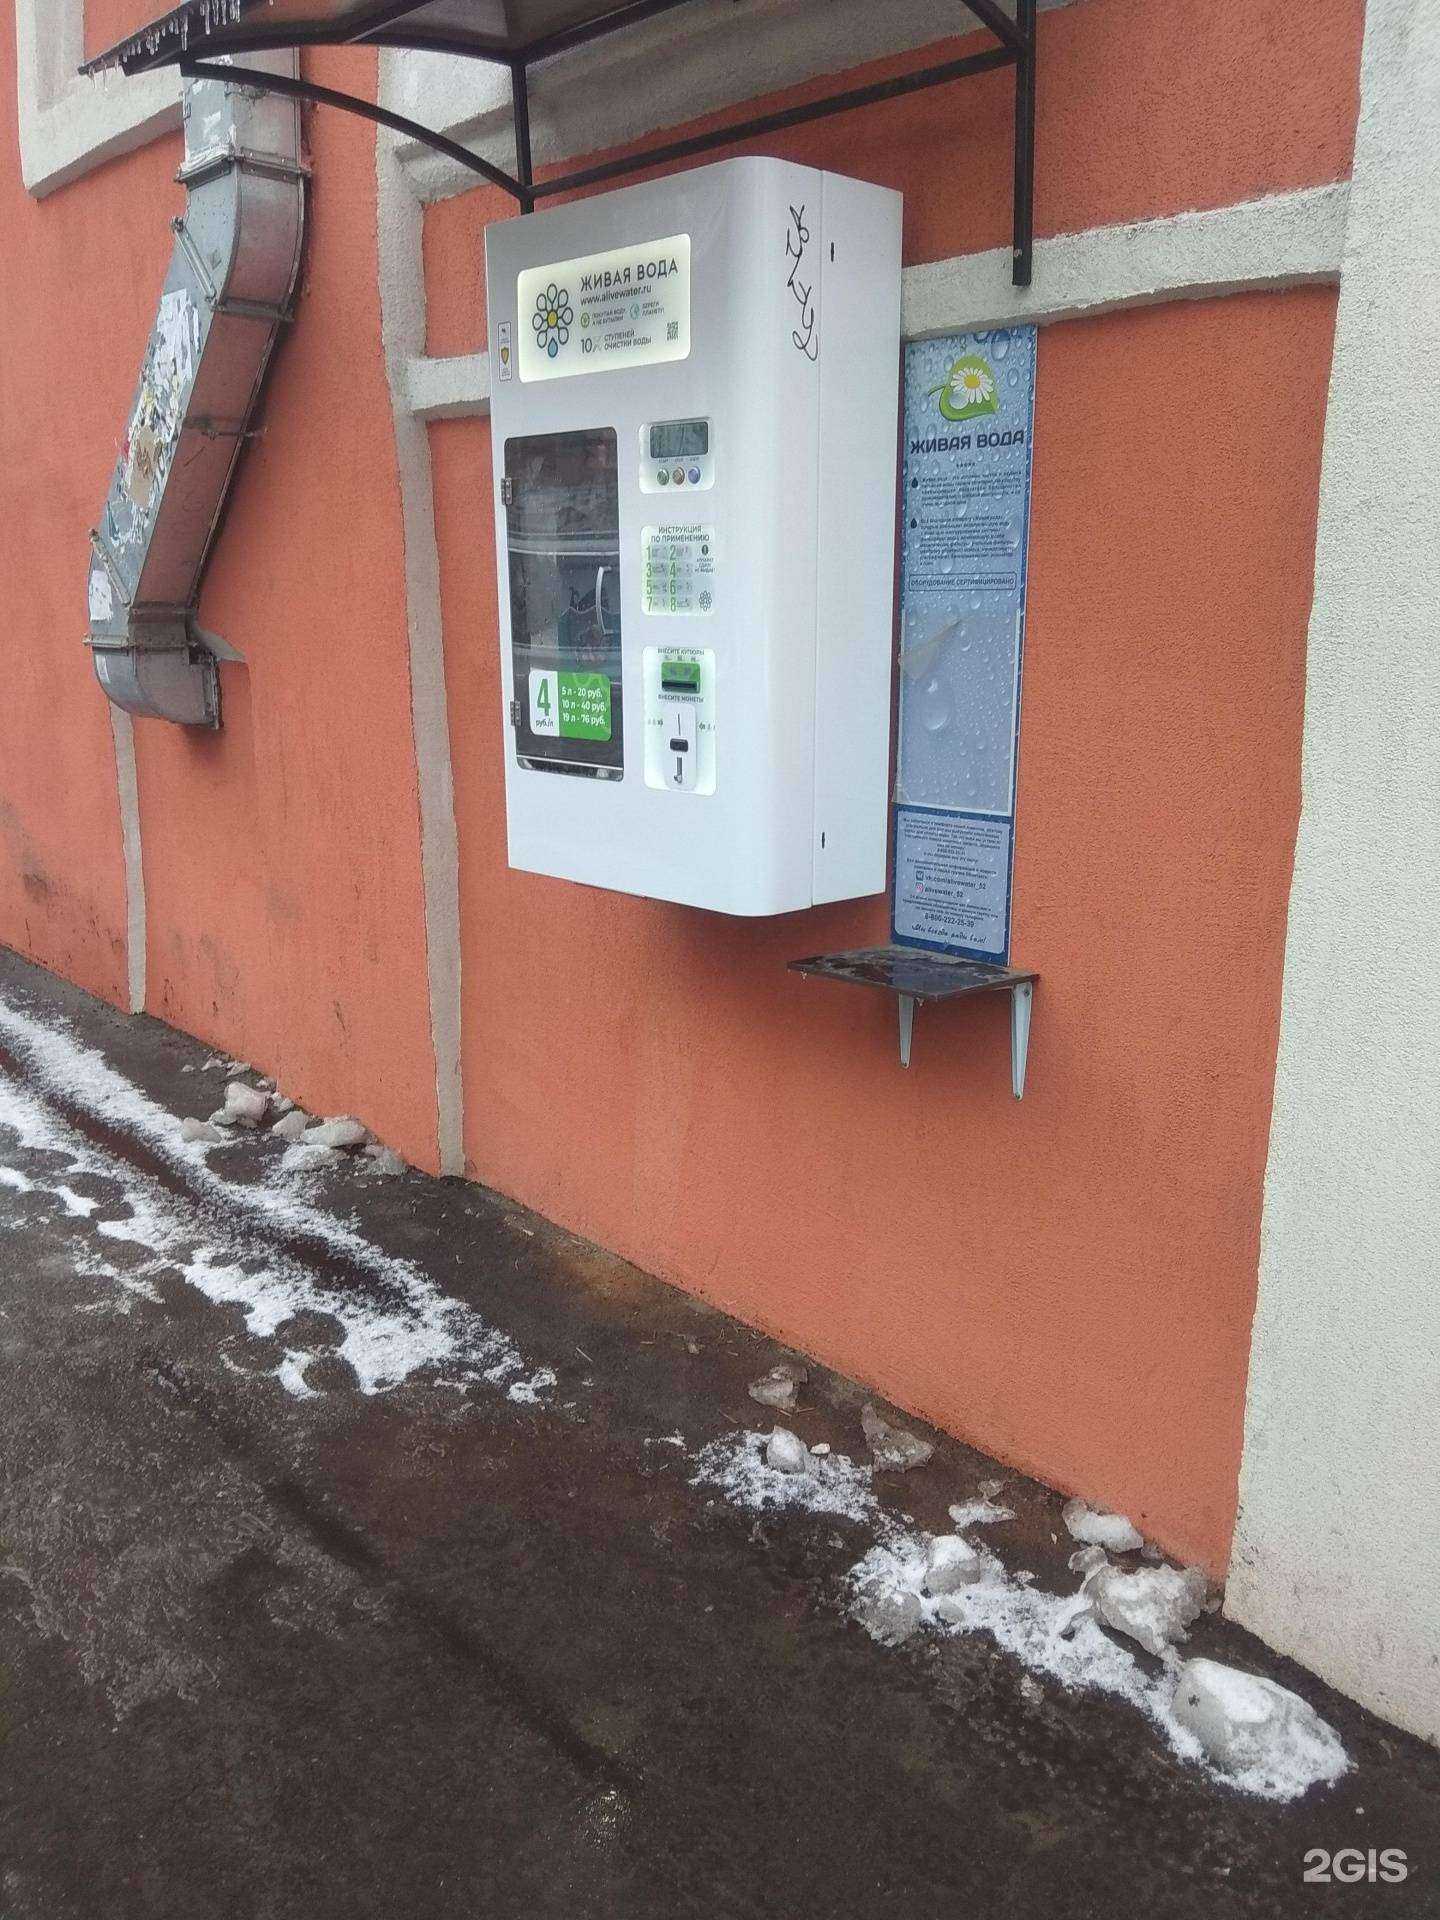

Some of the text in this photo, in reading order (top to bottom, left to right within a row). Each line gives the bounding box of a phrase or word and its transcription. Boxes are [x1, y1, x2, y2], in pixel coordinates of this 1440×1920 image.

[580, 258, 678, 291] ЖИВАЯ ВОДА
[580, 284, 652, 306] www.alivewater.ru
[604, 328, 634, 342] СТУПЕНЕЙ
[580, 338, 592, 354] 10
[604, 336, 652, 351] ОЧИСТКИ ВОДЫ
[911, 430, 1024, 454] ЖИВАЯ ВОДА
[658, 525, 702, 535] ИНСТРУКЦИЯ
[661, 534, 710, 542] ПРИМЕНЕНИЮ
[646, 546, 651, 560] 1
[669, 545, 676, 561] 2
[646, 562, 652, 578] 3
[669, 562, 676, 578] 4
[646, 580, 652, 595] 5
[669, 580, 676, 595] 6
[646, 596, 652, 612] 7
[670, 597, 676, 612] 8
[537, 678, 551, 716] 4
[561, 686, 566, 695] 5
[577, 687, 587, 696] 20
[587, 688, 603, 699] руб.
[562, 699, 570, 708] 10
[570, 701, 575, 709] л
[581, 701, 590, 710] 40
[591, 702, 607, 713] руб.
[562, 713, 570, 721] 19
[570, 714, 576, 722] л
[581, 714, 590, 724] 76
[591, 715, 606, 726] руб.
